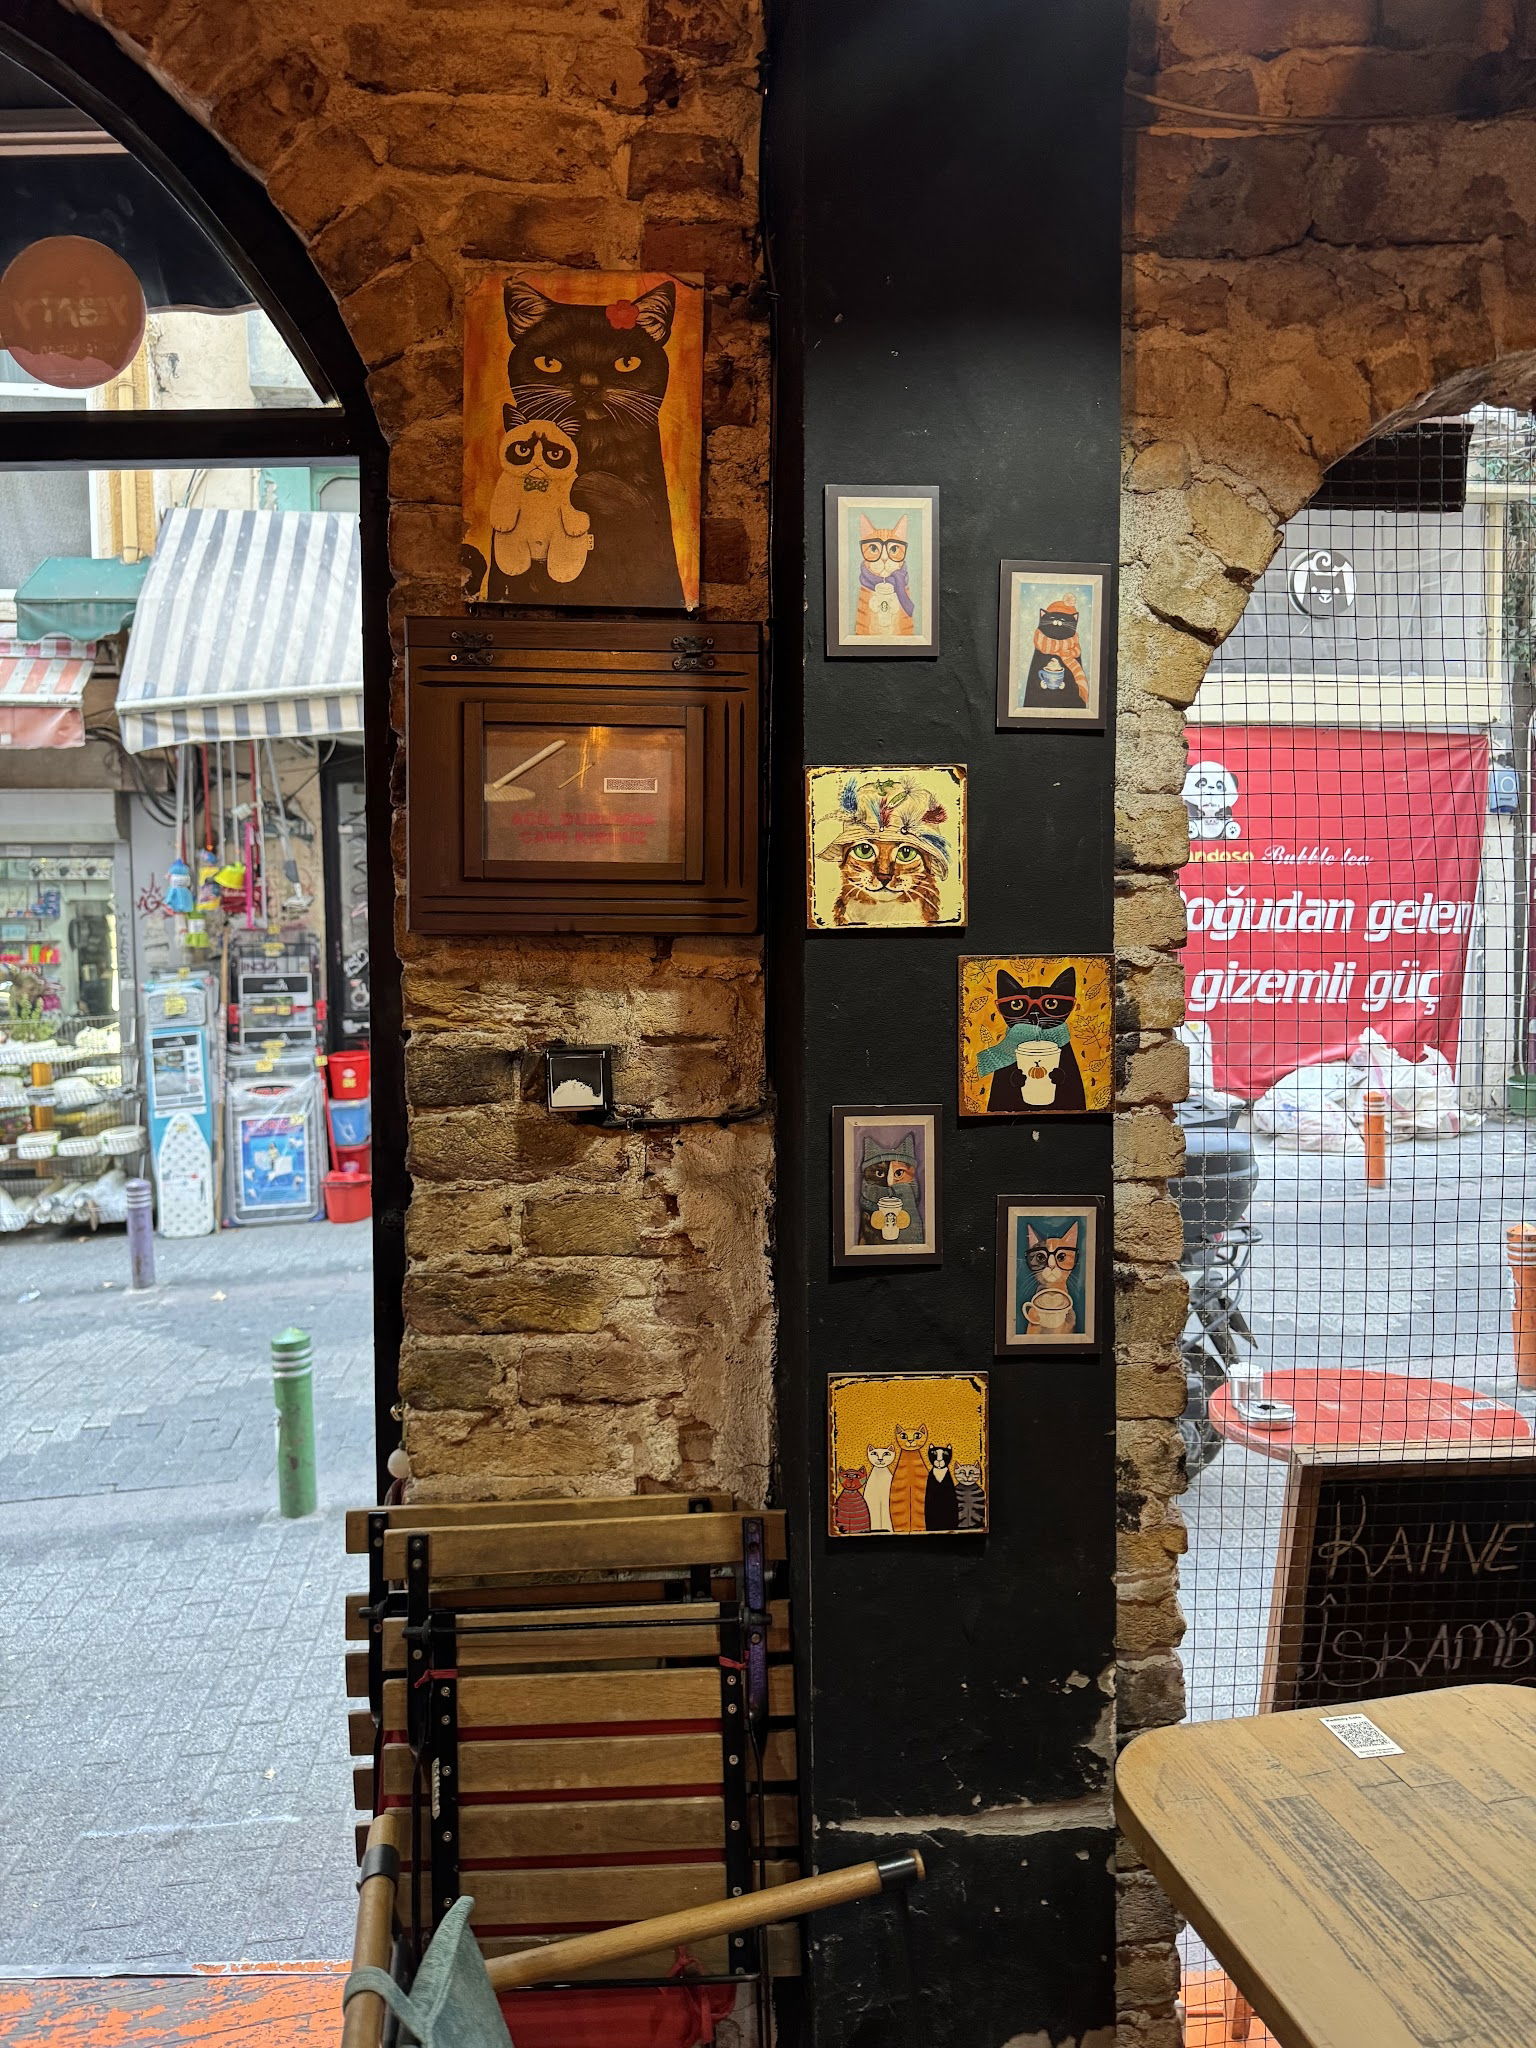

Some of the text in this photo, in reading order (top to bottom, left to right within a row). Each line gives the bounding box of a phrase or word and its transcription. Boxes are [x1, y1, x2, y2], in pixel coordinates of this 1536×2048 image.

[1261, 844, 1338, 865] Bubble
[1180, 886, 1356, 941] oğudan
[1187, 960, 1444, 1016] gizemli güç
[1318, 1495, 1535, 1579] KAHVE
